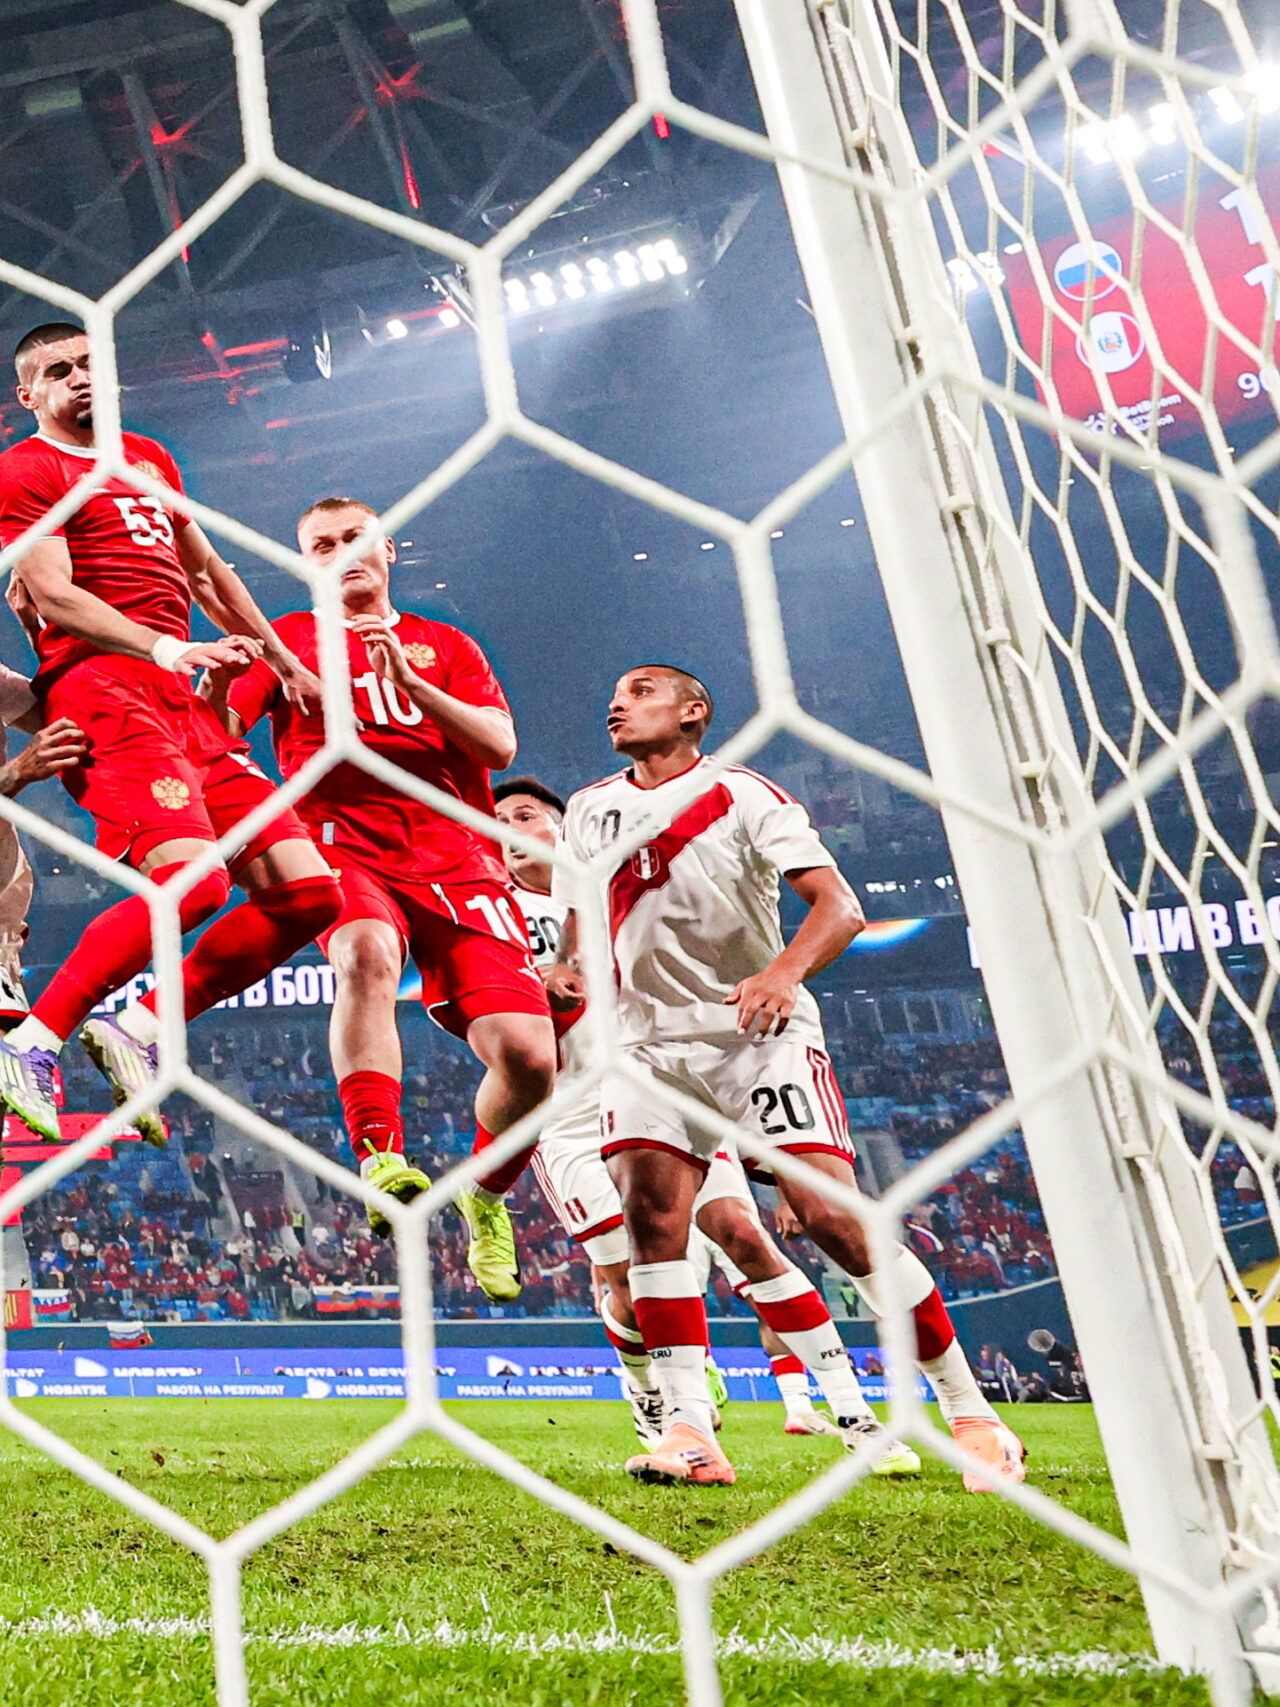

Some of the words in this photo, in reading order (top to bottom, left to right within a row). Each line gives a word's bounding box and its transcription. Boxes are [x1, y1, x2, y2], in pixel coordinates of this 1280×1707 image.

[113, 496, 175, 546] 53
[353, 671, 423, 726] 10
[751, 1083, 815, 1135] 20
[43, 1384, 108, 1396] НОВАТЭК
[157, 1384, 202, 1396] РАБОТА
[204, 1384, 222, 1396] НА
[224, 1384, 285, 1396] РЕЗУЛЬТАТ
[335, 1384, 405, 1396] НОВАТЭК
